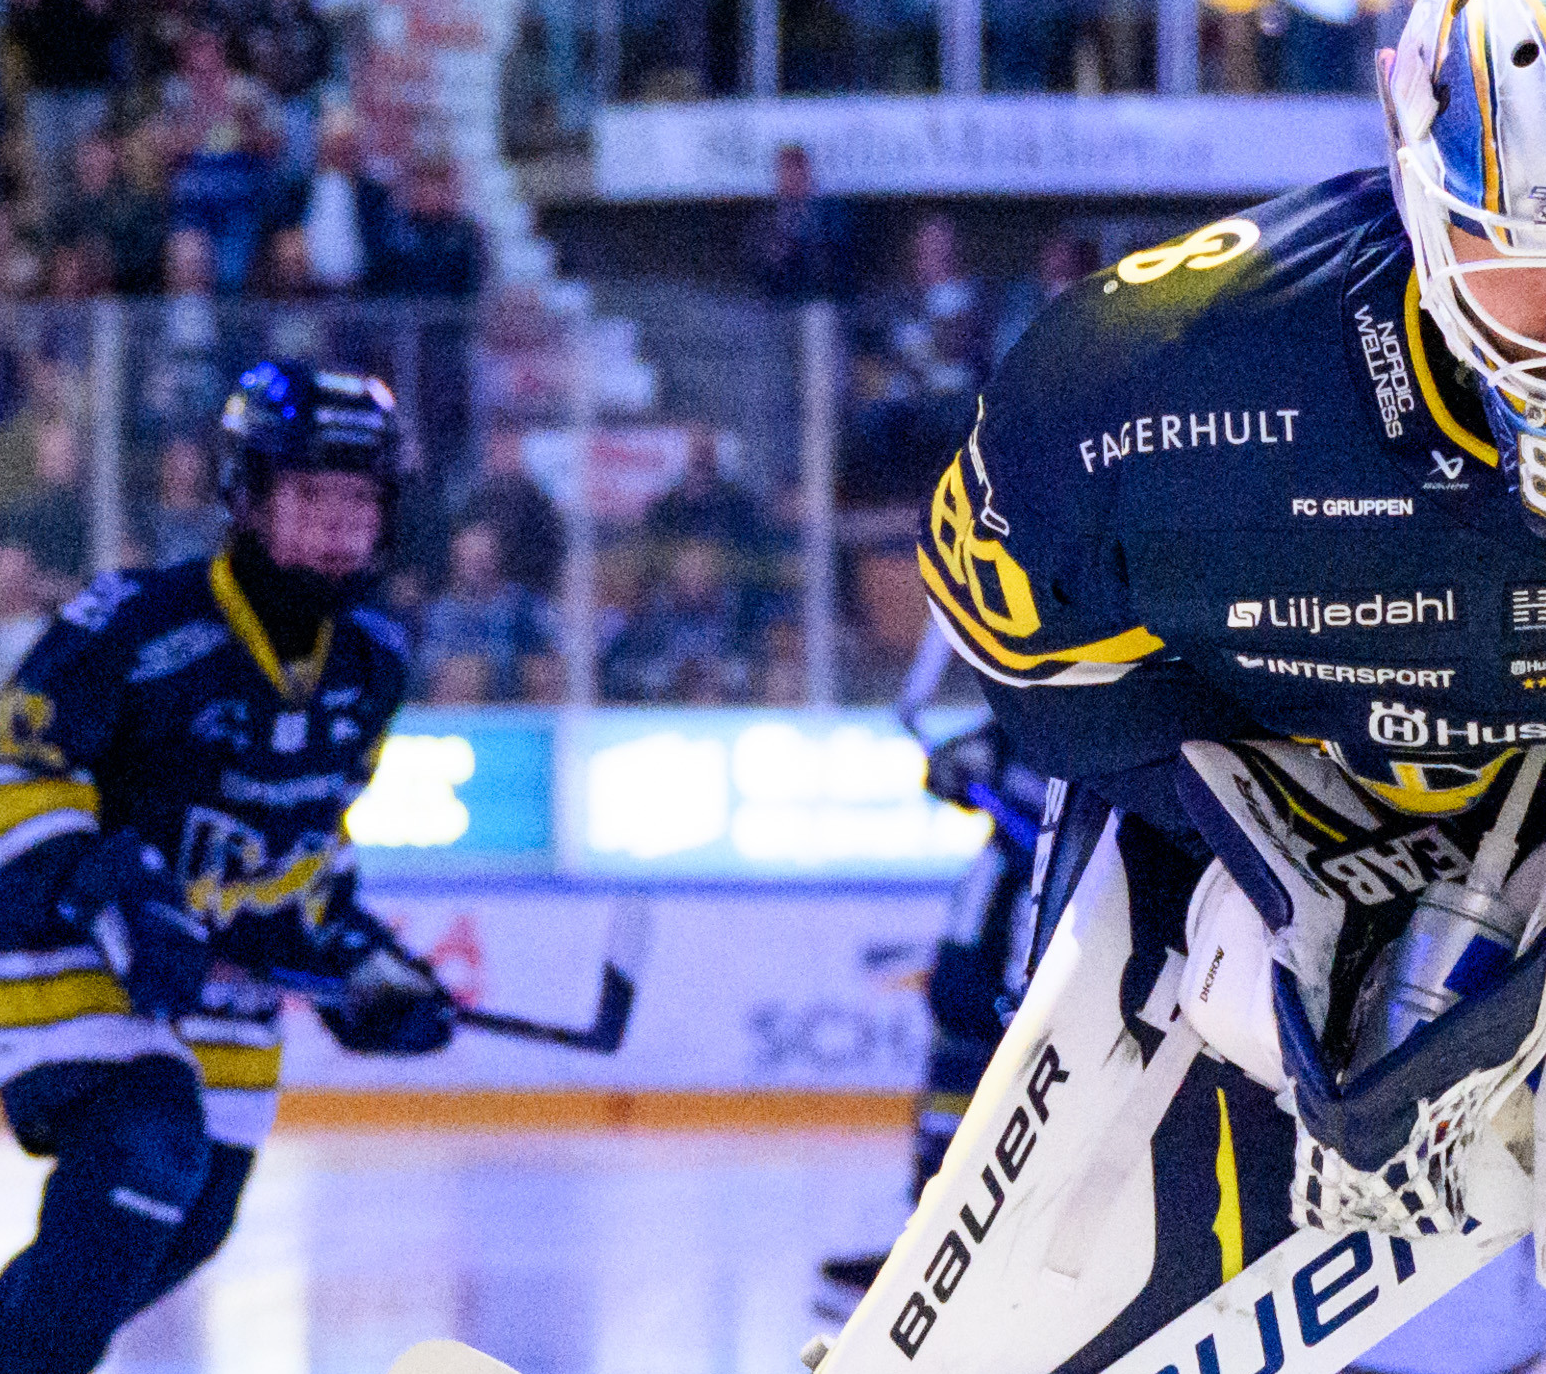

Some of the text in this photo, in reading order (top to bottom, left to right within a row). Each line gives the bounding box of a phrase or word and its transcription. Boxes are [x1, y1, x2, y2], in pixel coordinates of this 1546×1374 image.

[1353, 304, 1404, 440] WELLNESS
[1377, 321, 1416, 414] NORDIC
[1079, 409, 1300, 473] FAGERHULT
[1292, 498, 1413, 517] FC GRUPPEN
[1270, 590, 1455, 634] Liljedahl
[1268, 658, 1455, 689] INTERSPORT
[1320, 824, 1473, 906] EAB
[889, 1041, 1070, 1361] BAUER
